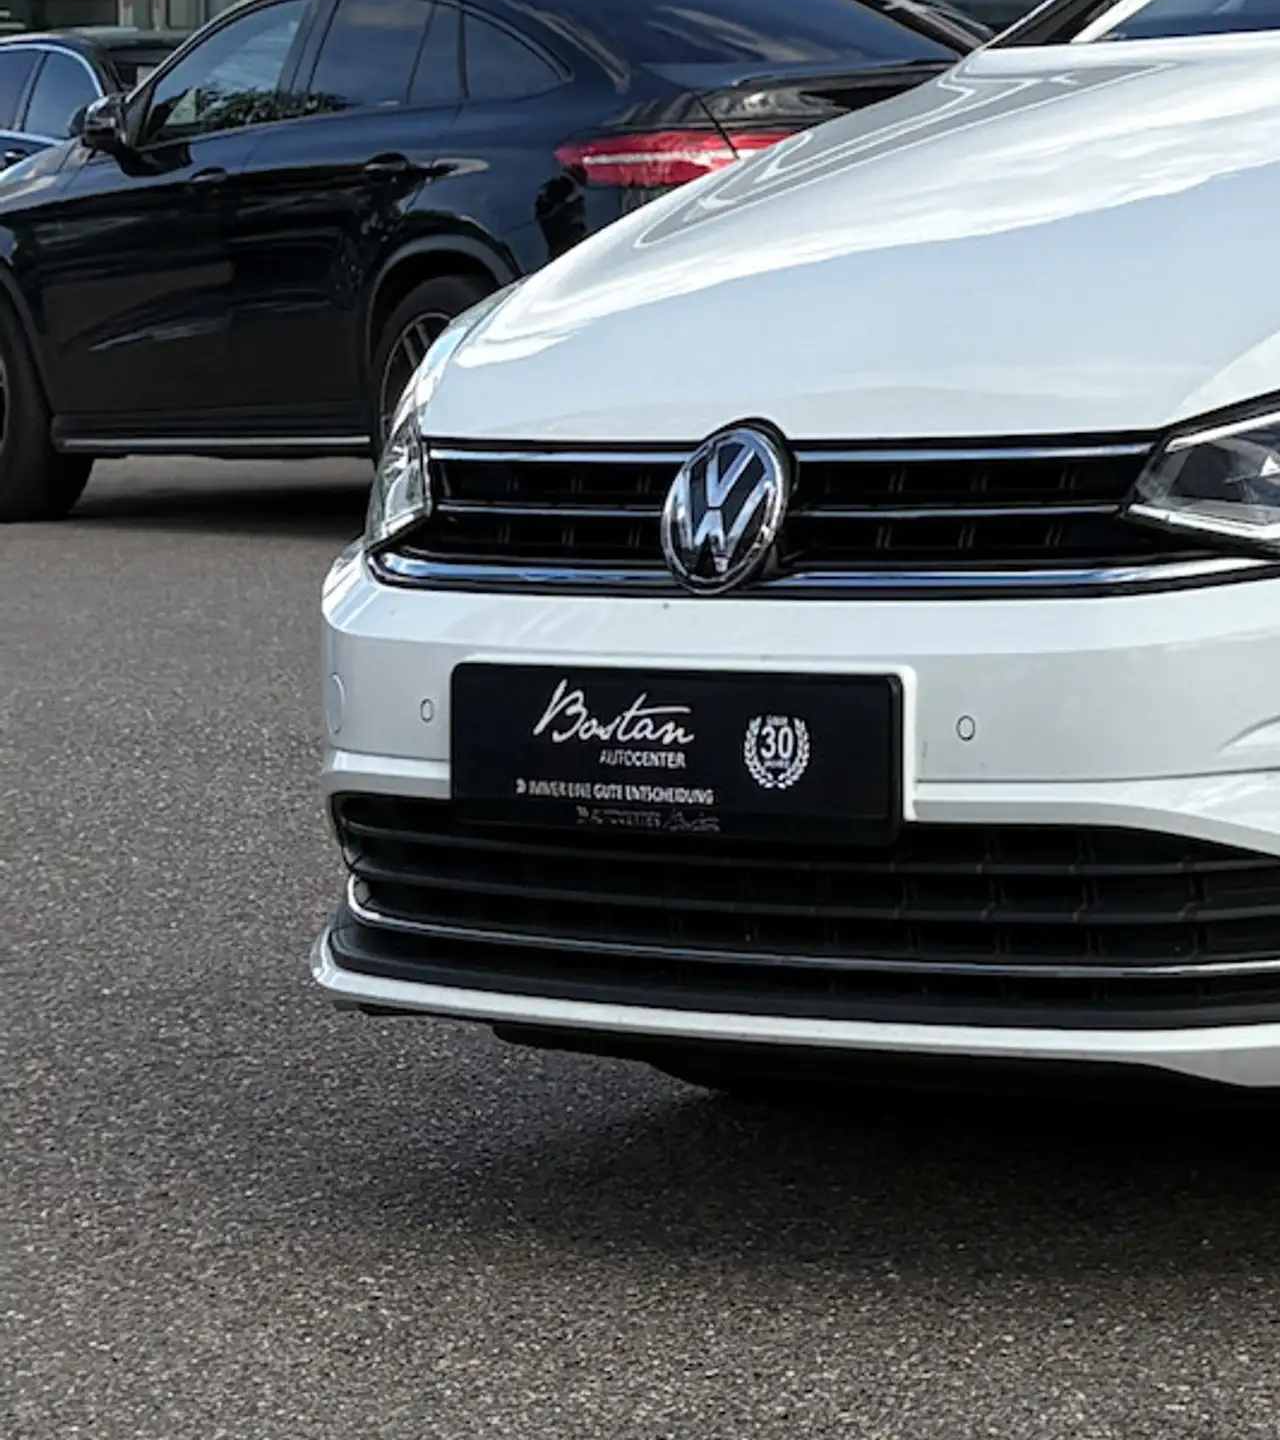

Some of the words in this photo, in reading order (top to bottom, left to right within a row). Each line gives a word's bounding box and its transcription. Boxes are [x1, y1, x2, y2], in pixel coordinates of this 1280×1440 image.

[533, 678, 694, 744] Bostan
[599, 749, 686, 769] AUTOCENTER
[760, 725, 794, 760] 30
